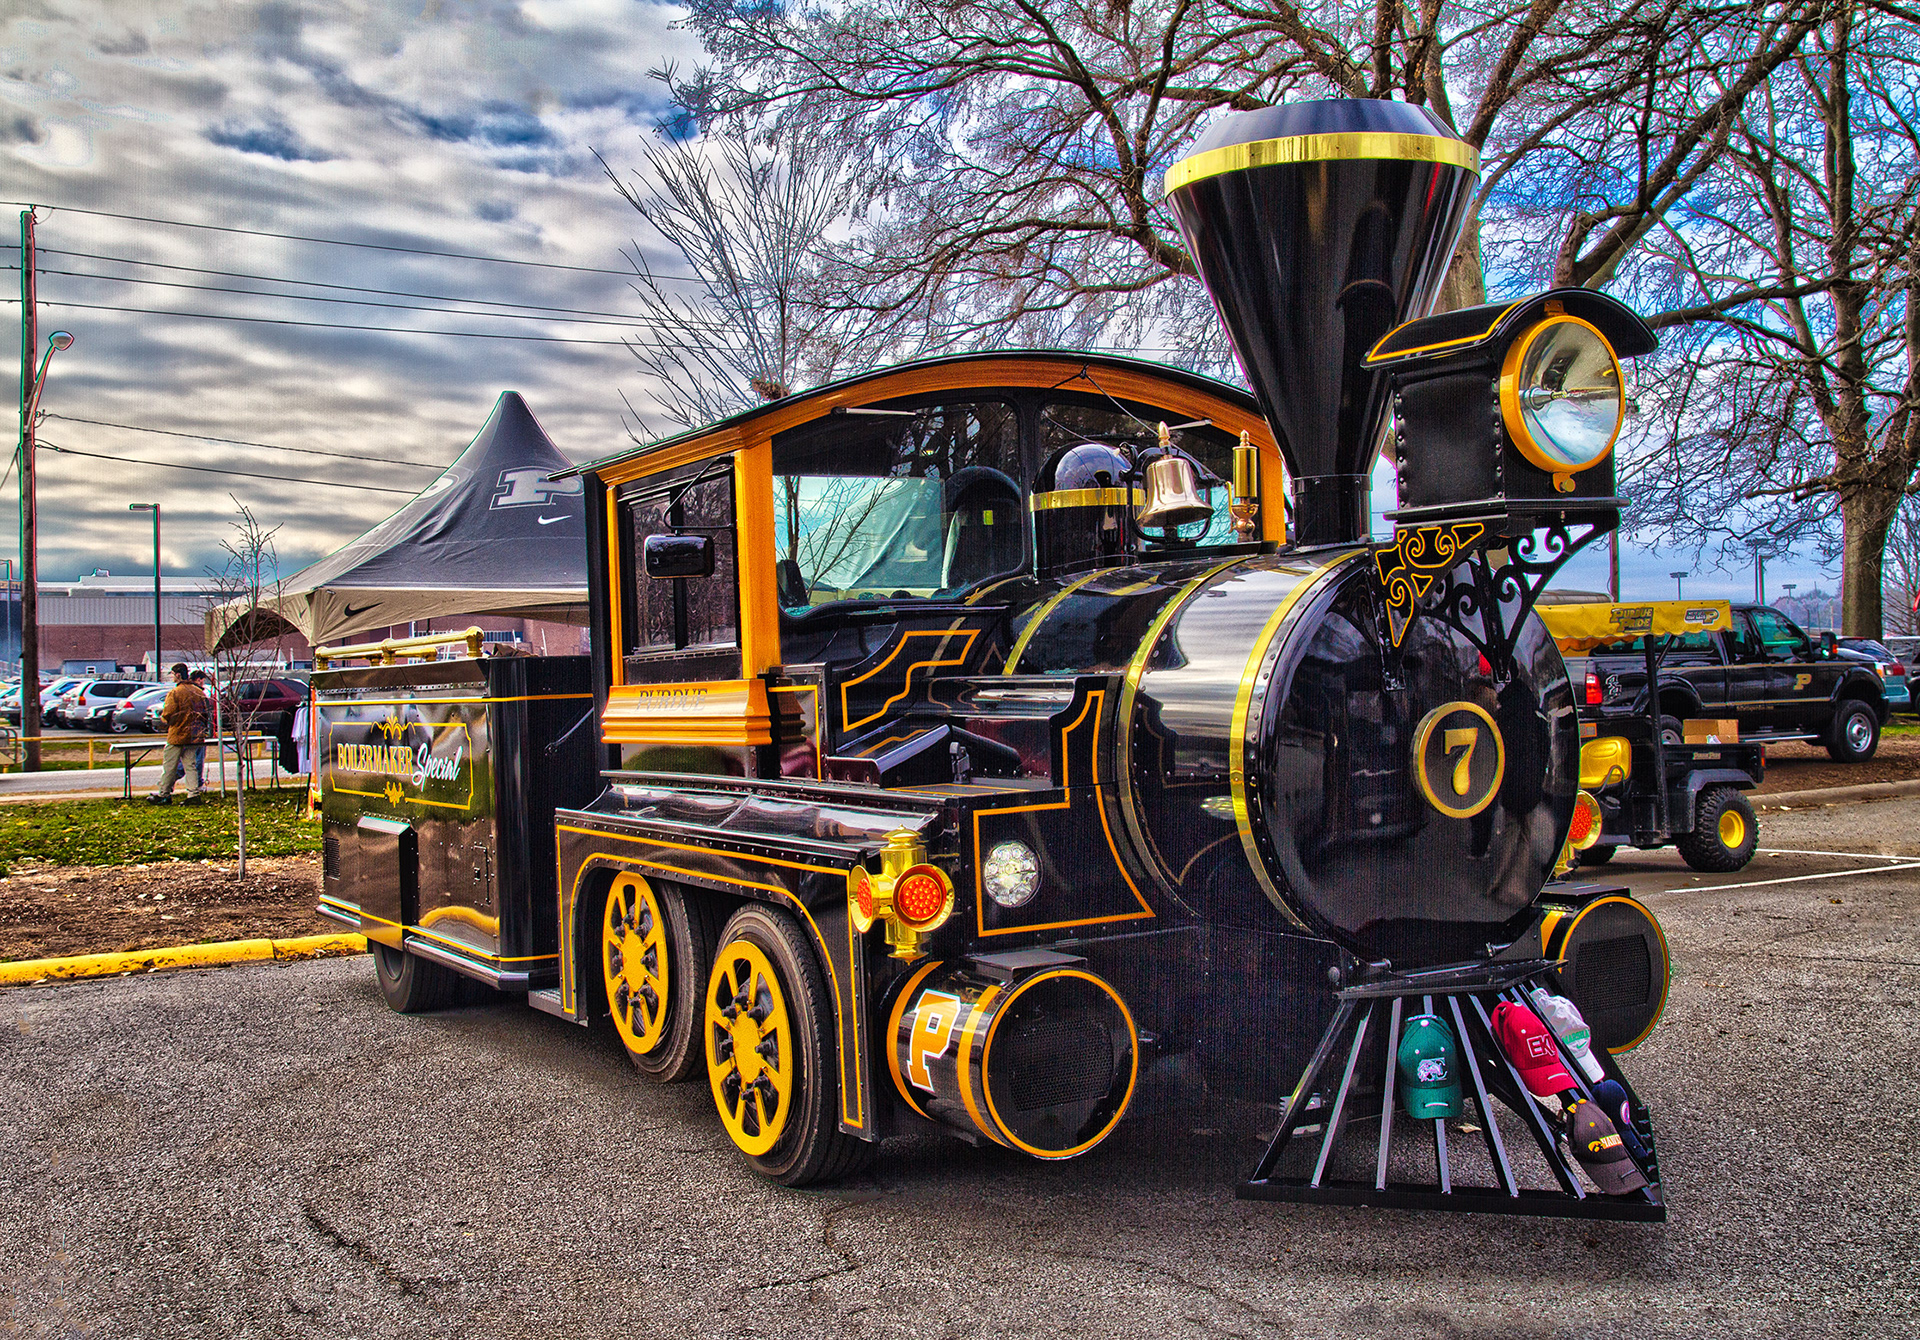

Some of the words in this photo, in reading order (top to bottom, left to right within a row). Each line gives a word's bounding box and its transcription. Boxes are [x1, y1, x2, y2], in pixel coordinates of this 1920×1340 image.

[490, 466, 584, 510] P
[1610, 607, 1653, 623] PURDUE
[1617, 618, 1652, 633] PRIDE
[1793, 673, 1812, 690] P
[635, 688, 708, 712] PURDUE
[337, 743, 413, 776] BOILERMAKER
[411, 742, 463, 792] Special
[1444, 727, 1478, 796] 7
[907, 988, 961, 1093] P
